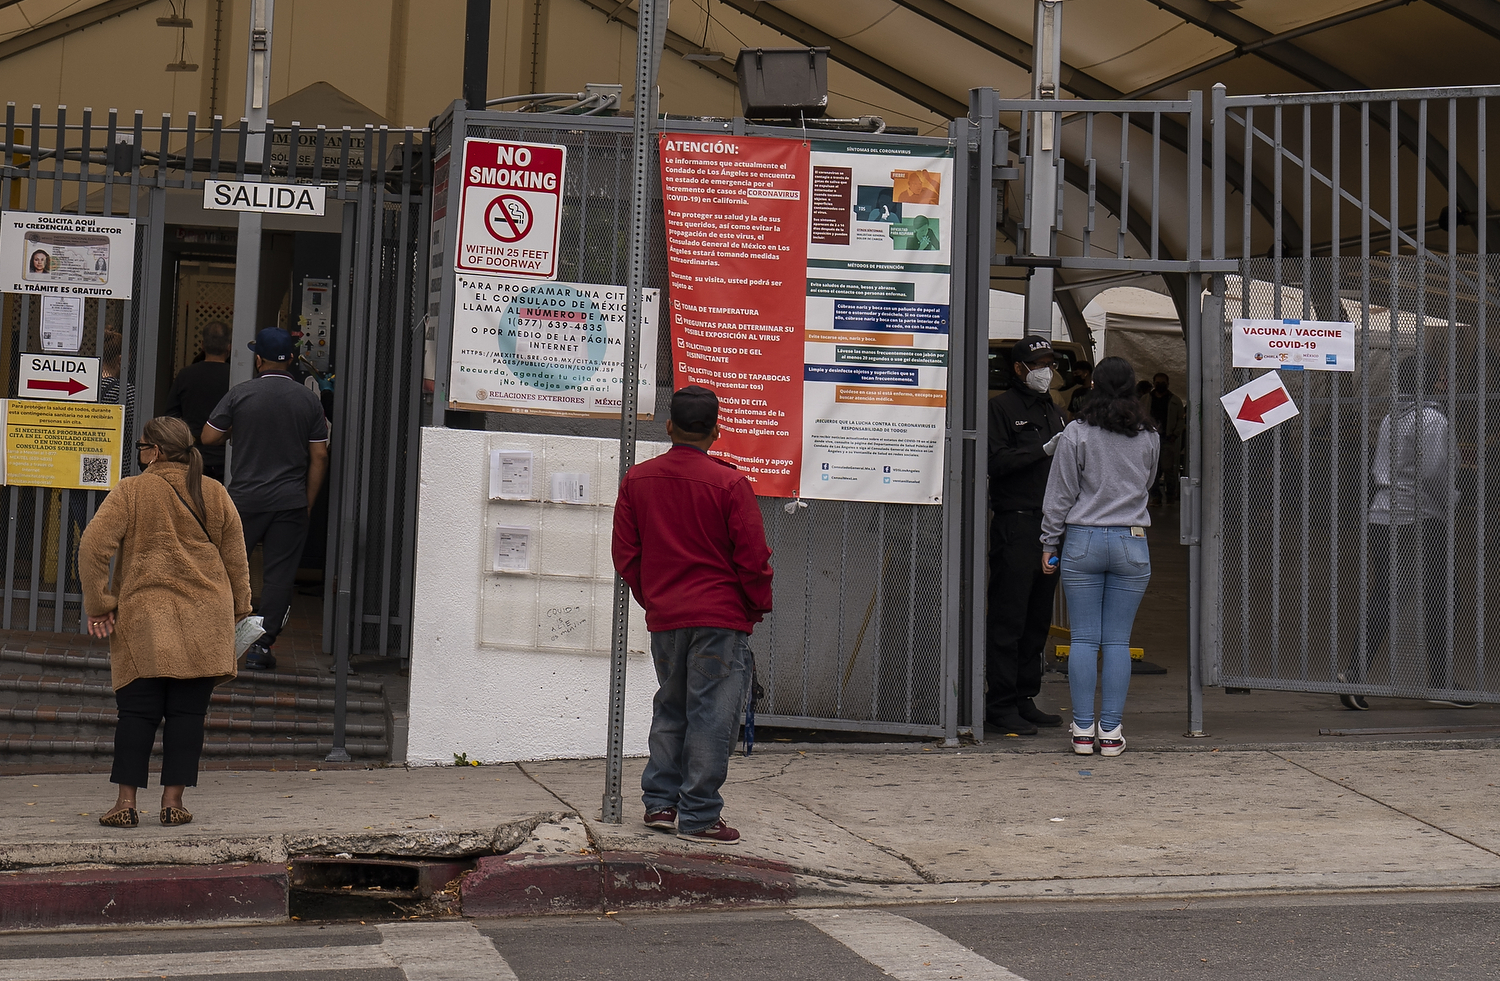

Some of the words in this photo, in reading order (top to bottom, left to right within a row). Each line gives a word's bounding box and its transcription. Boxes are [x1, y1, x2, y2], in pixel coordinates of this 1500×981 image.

[272, 133, 366, 148] IMORANTE
[666, 139, 739, 154] ATENCIÓN:
[497, 145, 531, 166] NO
[674, 156, 718, 165] informamos
[470, 166, 556, 190] SMOKING
[665, 166, 695, 174] Condado
[720, 168, 748, 177] Ángeles
[710, 178, 752, 187] emergencia
[214, 184, 315, 211] SALIDA
[667, 193, 701, 203] (COVID-19)
[712, 196, 749, 204] California.
[748, 189, 798, 197] CORONAVIRUS
[25, 223, 73, 231] CREDENCIAL
[74, 218, 95, 226] AQUÍ
[466, 244, 504, 255] WITHIN
[506, 248, 519, 257] 25
[521, 249, 549, 259] FEET
[469, 255, 483, 264] OF
[485, 256, 541, 269] DOORWAY
[24, 283, 58, 292] TRÁMITE
[71, 287, 112, 295] GRATUITO
[463, 280, 491, 290] PARA
[497, 283, 570, 296] PROGRAMAR
[576, 289, 599, 298] UNA
[606, 292, 624, 301] CIT
[476, 292, 486, 300] EL
[492, 294, 566, 307] CONSULADO
[571, 300, 585, 308] DE
[589, 299, 627, 314] MÉXIC
[463, 302, 501, 313] LLAMA
[506, 306, 521, 314] AL
[526, 308, 575, 318] NÚMERO
[580, 312, 594, 320] DE
[508, 315, 542, 328] 1(877)
[547, 320, 602, 331] 639-4835
[482, 327, 504, 336] POR
[507, 329, 541, 338] MEDIO
[546, 332, 558, 340] DE
[580, 335, 621, 345] PÁGINA
[1243, 327, 1286, 335] VACUNA
[1294, 328, 1341, 337] VACCINE
[530, 341, 578, 351] INTERNET
[1269, 340, 1316, 349] COVID-19
[32, 358, 86, 374] SALIDA
[489, 390, 536, 400] RELACIONES
[537, 394, 584, 403] EXTERIORES
[594, 398, 622, 406] MÉXIC
